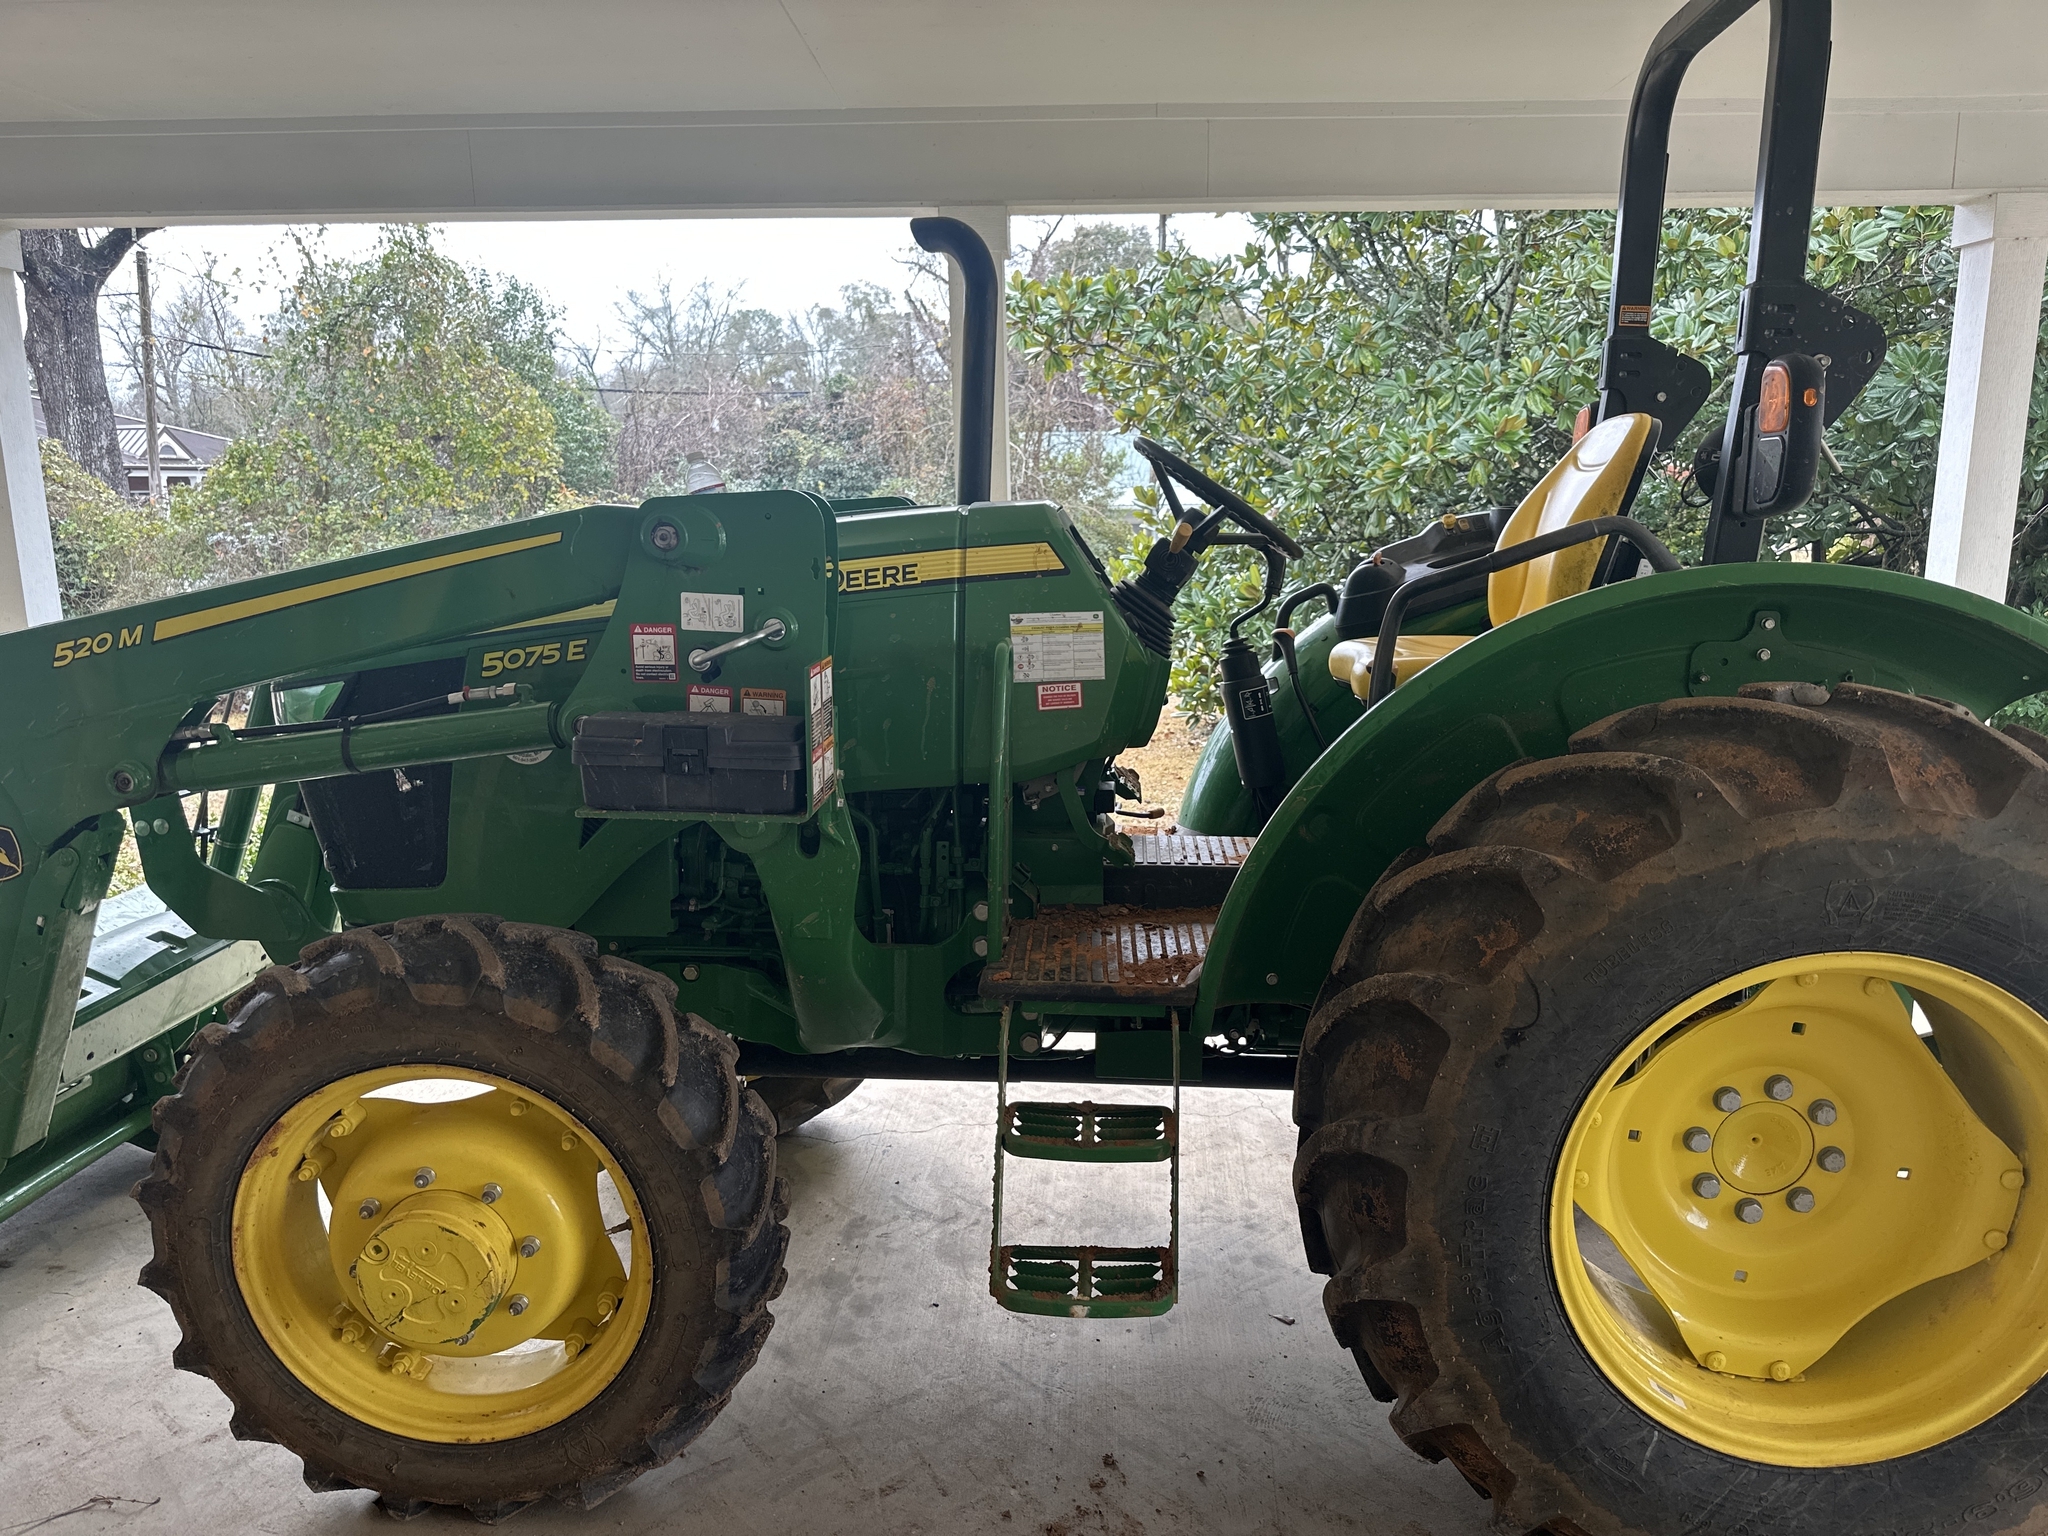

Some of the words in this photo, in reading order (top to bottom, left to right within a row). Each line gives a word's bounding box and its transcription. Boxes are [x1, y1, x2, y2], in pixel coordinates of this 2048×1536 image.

[53, 632, 113, 668] 520
[118, 624, 144, 649] M
[481, 642, 562, 678] 5075
[566, 638, 589, 662] E
[700, 686, 729, 695] DANGER
[752, 691, 784, 699] WARNING
[1042, 684, 1077, 692] NOTICE
[1583, 918, 1674, 985] TUBELESS
[392, 1258, 425, 1285] LEVEL
[424, 1280, 442, 1296] OIL
